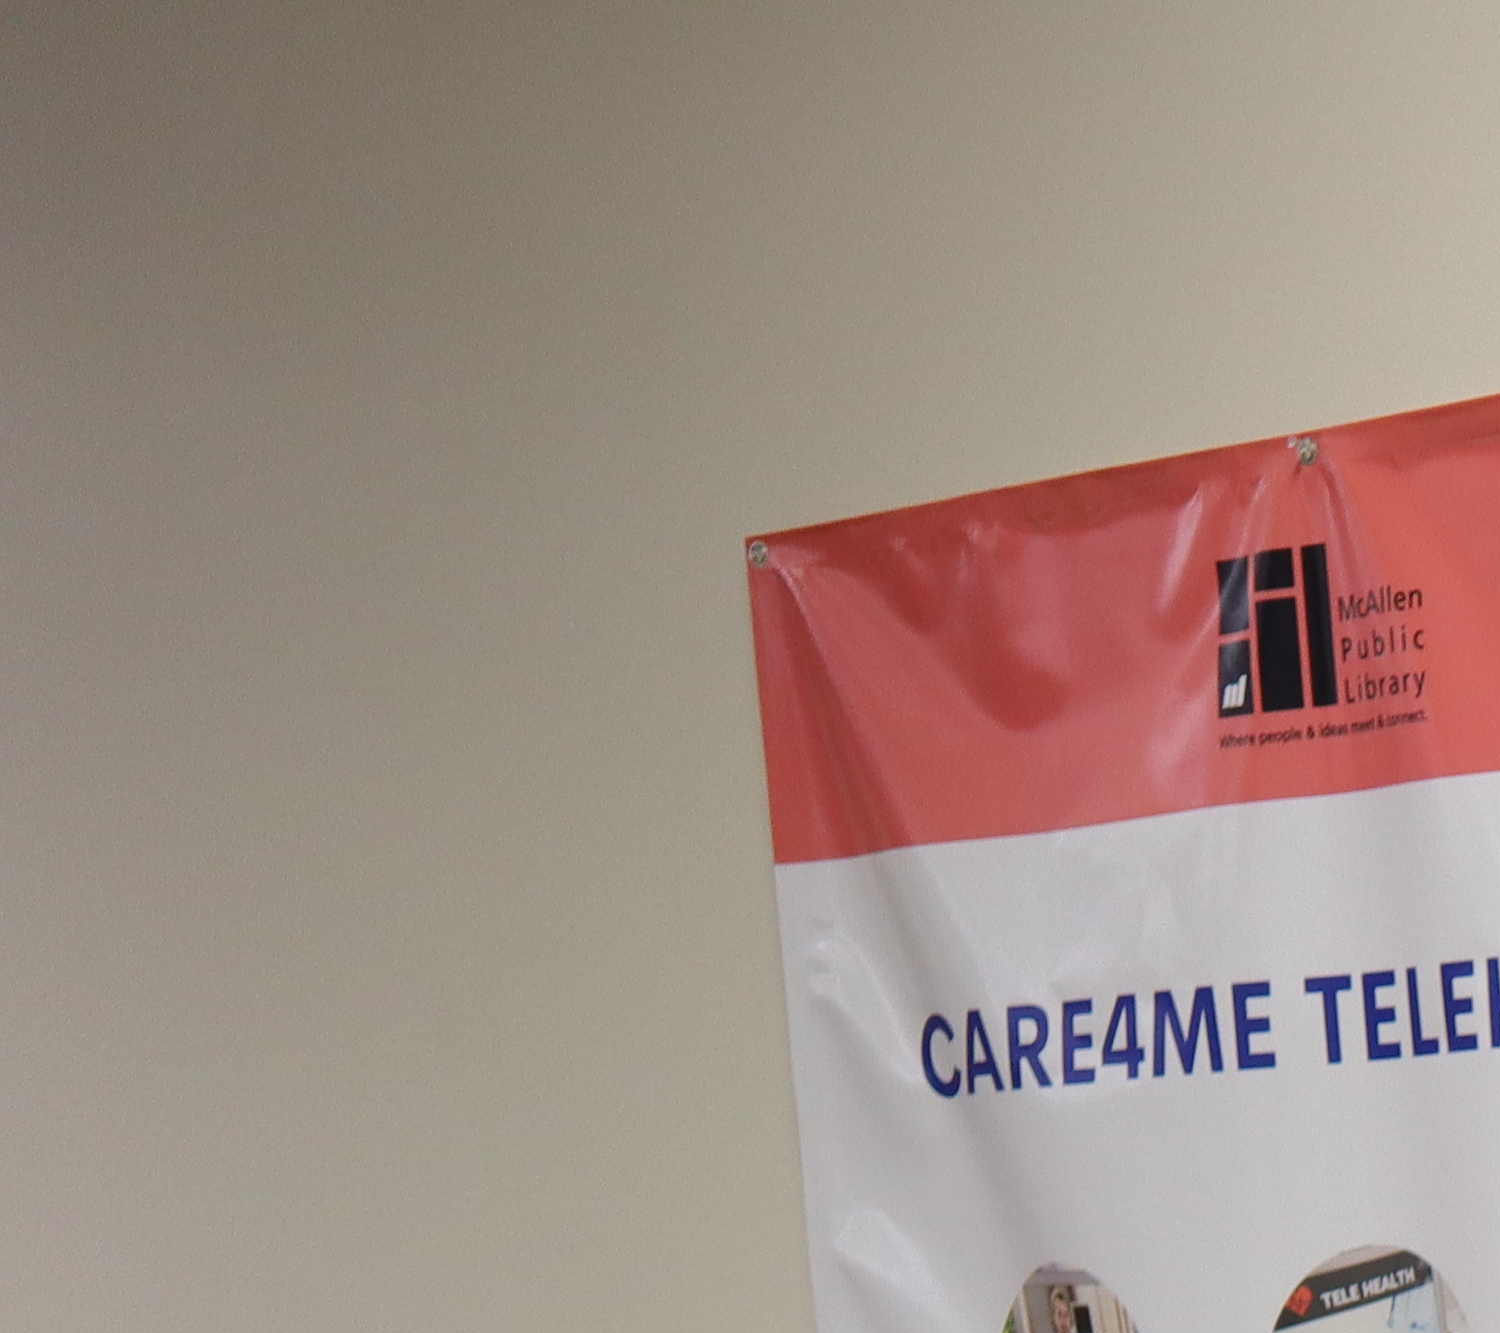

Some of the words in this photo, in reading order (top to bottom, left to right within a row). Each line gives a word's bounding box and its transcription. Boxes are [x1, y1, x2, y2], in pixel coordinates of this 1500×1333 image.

[1337, 586, 1423, 621] McAllen
[1341, 626, 1425, 662] Public
[1343, 668, 1426, 704] Library
[1259, 728, 1302, 747] people
[1306, 725, 1315, 739] &
[918, 979, 1278, 1100] CARE4ME
[1319, 1282, 1362, 1310] TELE
[1362, 1266, 1416, 1299] HEALTH
